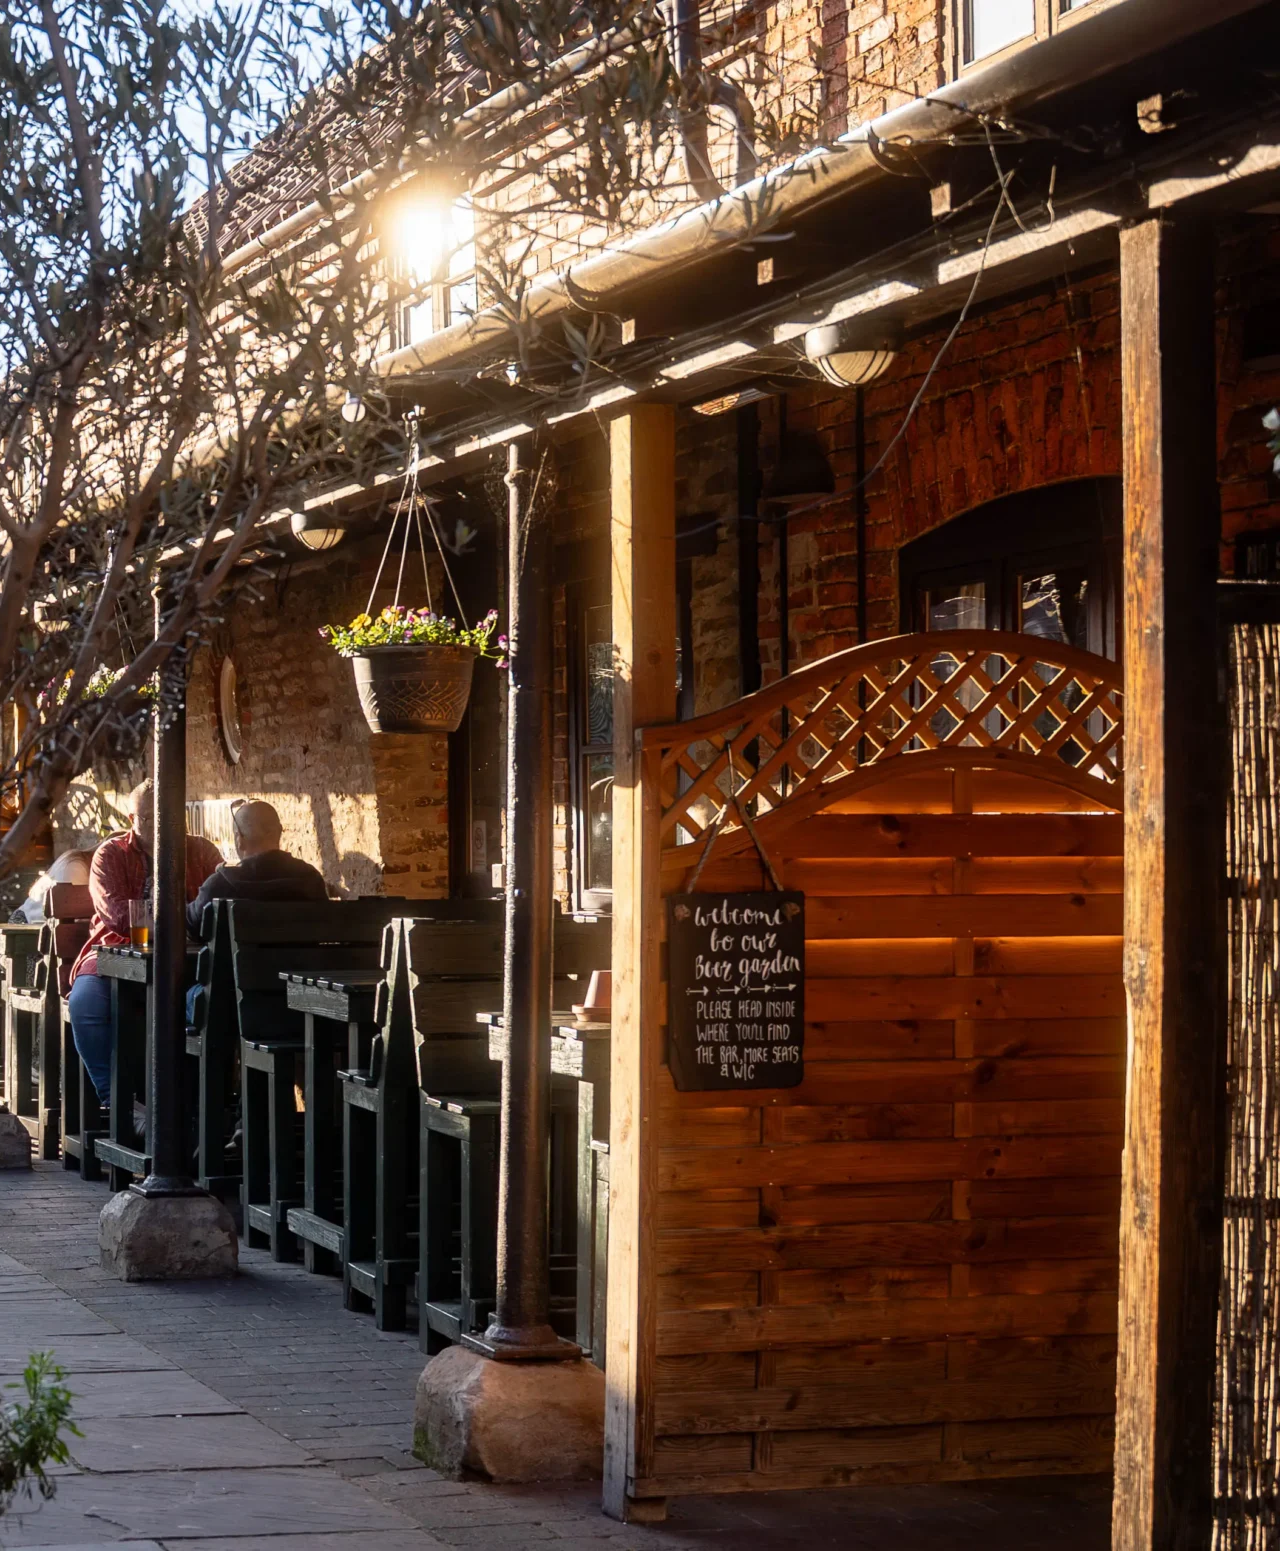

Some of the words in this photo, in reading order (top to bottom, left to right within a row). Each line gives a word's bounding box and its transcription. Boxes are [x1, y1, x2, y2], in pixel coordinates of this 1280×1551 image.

[694, 899, 784, 926] welcome
[710, 928, 734, 952] to
[741, 932, 777, 952] our
[695, 955, 732, 981] Beer
[739, 950, 801, 988] garden
[696, 1001, 732, 1019] PLEASE
[738, 1001, 762, 1018] HEAD
[765, 1001, 796, 1017] INSIDE
[696, 1024, 729, 1042] WHERE
[767, 1024, 790, 1040] FIND
[695, 1047, 714, 1064] THE
[743, 1047, 768, 1063] MORE
[772, 1046, 799, 1063] SEATS
[720, 1064, 729, 1077] &
